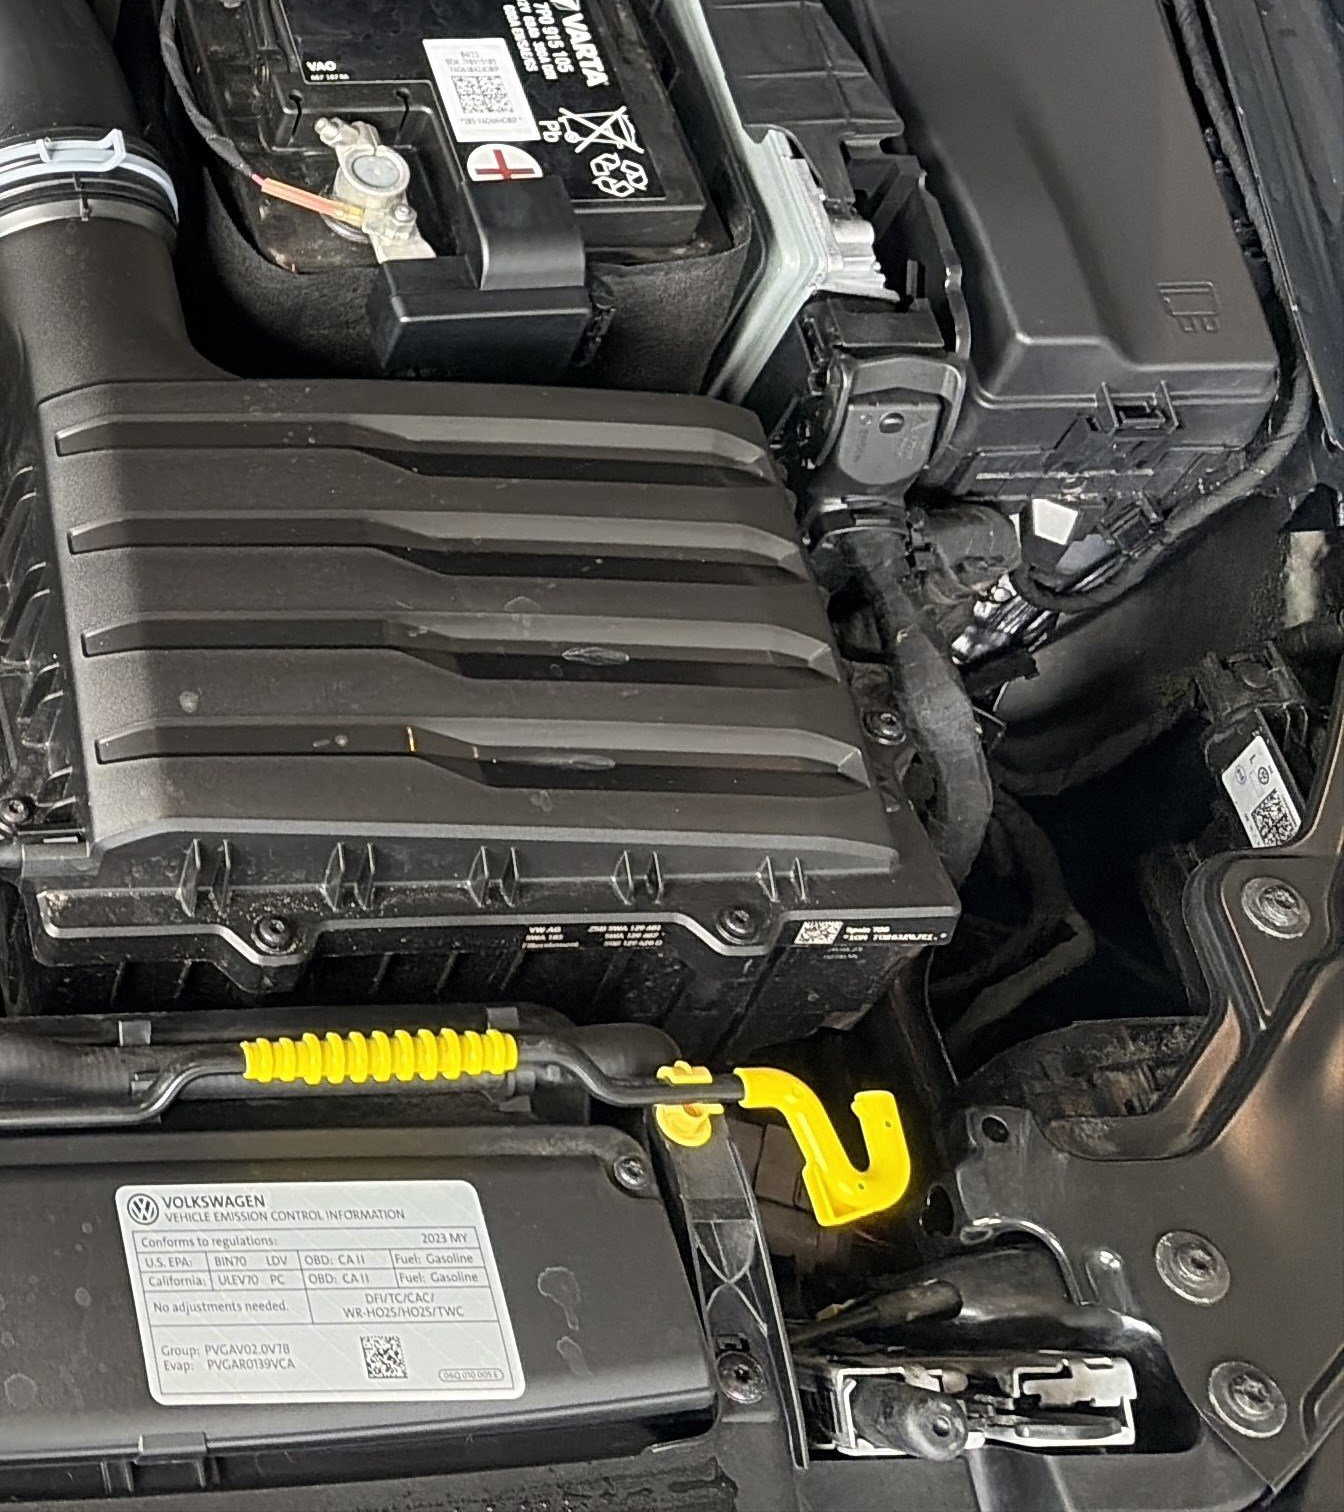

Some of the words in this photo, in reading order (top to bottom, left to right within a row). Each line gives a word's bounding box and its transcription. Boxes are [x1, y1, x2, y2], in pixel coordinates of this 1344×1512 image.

[542, 27, 564, 48] 915
[562, 12, 608, 87] VARTA
[552, 51, 574, 72] 105
[538, 120, 560, 142] Pb
[163, 1195, 265, 1209] VOLKSWAGEN
[165, 1212, 210, 1223] VEHICLE
[214, 1211, 268, 1222] EMISSION
[271, 1210, 321, 1221] CONTROL
[326, 1209, 405, 1221] INFORMATION
[142, 1237, 195, 1248] Conforms
[198, 1238, 209, 1247] to
[213, 1237, 277, 1249] regulations:
[421, 1233, 447, 1244] 2023
[450, 1233, 467, 1243] MY
[145, 1258, 165, 1267] U.S.
[169, 1257, 192, 1267] EPA:
[215, 1256, 247, 1266] BIN70
[266, 1256, 288, 1266] LDV
[305, 1255, 333, 1265] OBD:
[339, 1255, 354, 1265] CA
[395, 1253, 421, 1264] Fuel:
[426, 1253, 473, 1264] Gasoline
[149, 1275, 207, 1286] California:
[218, 1274, 259, 1285] ULEV70
[270, 1274, 285, 1284] PC
[308, 1273, 337, 1284] OBD:
[343, 1273, 357, 1283] CA
[399, 1272, 425, 1283] Fuel:
[431, 1272, 478, 1282] Gasoline
[154, 1302, 169, 1313] No
[173, 1300, 242, 1315] adjustments
[245, 1299, 289, 1310] needed.
[162, 1345, 200, 1358] Group:
[164, 1361, 194, 1373] Evap:
